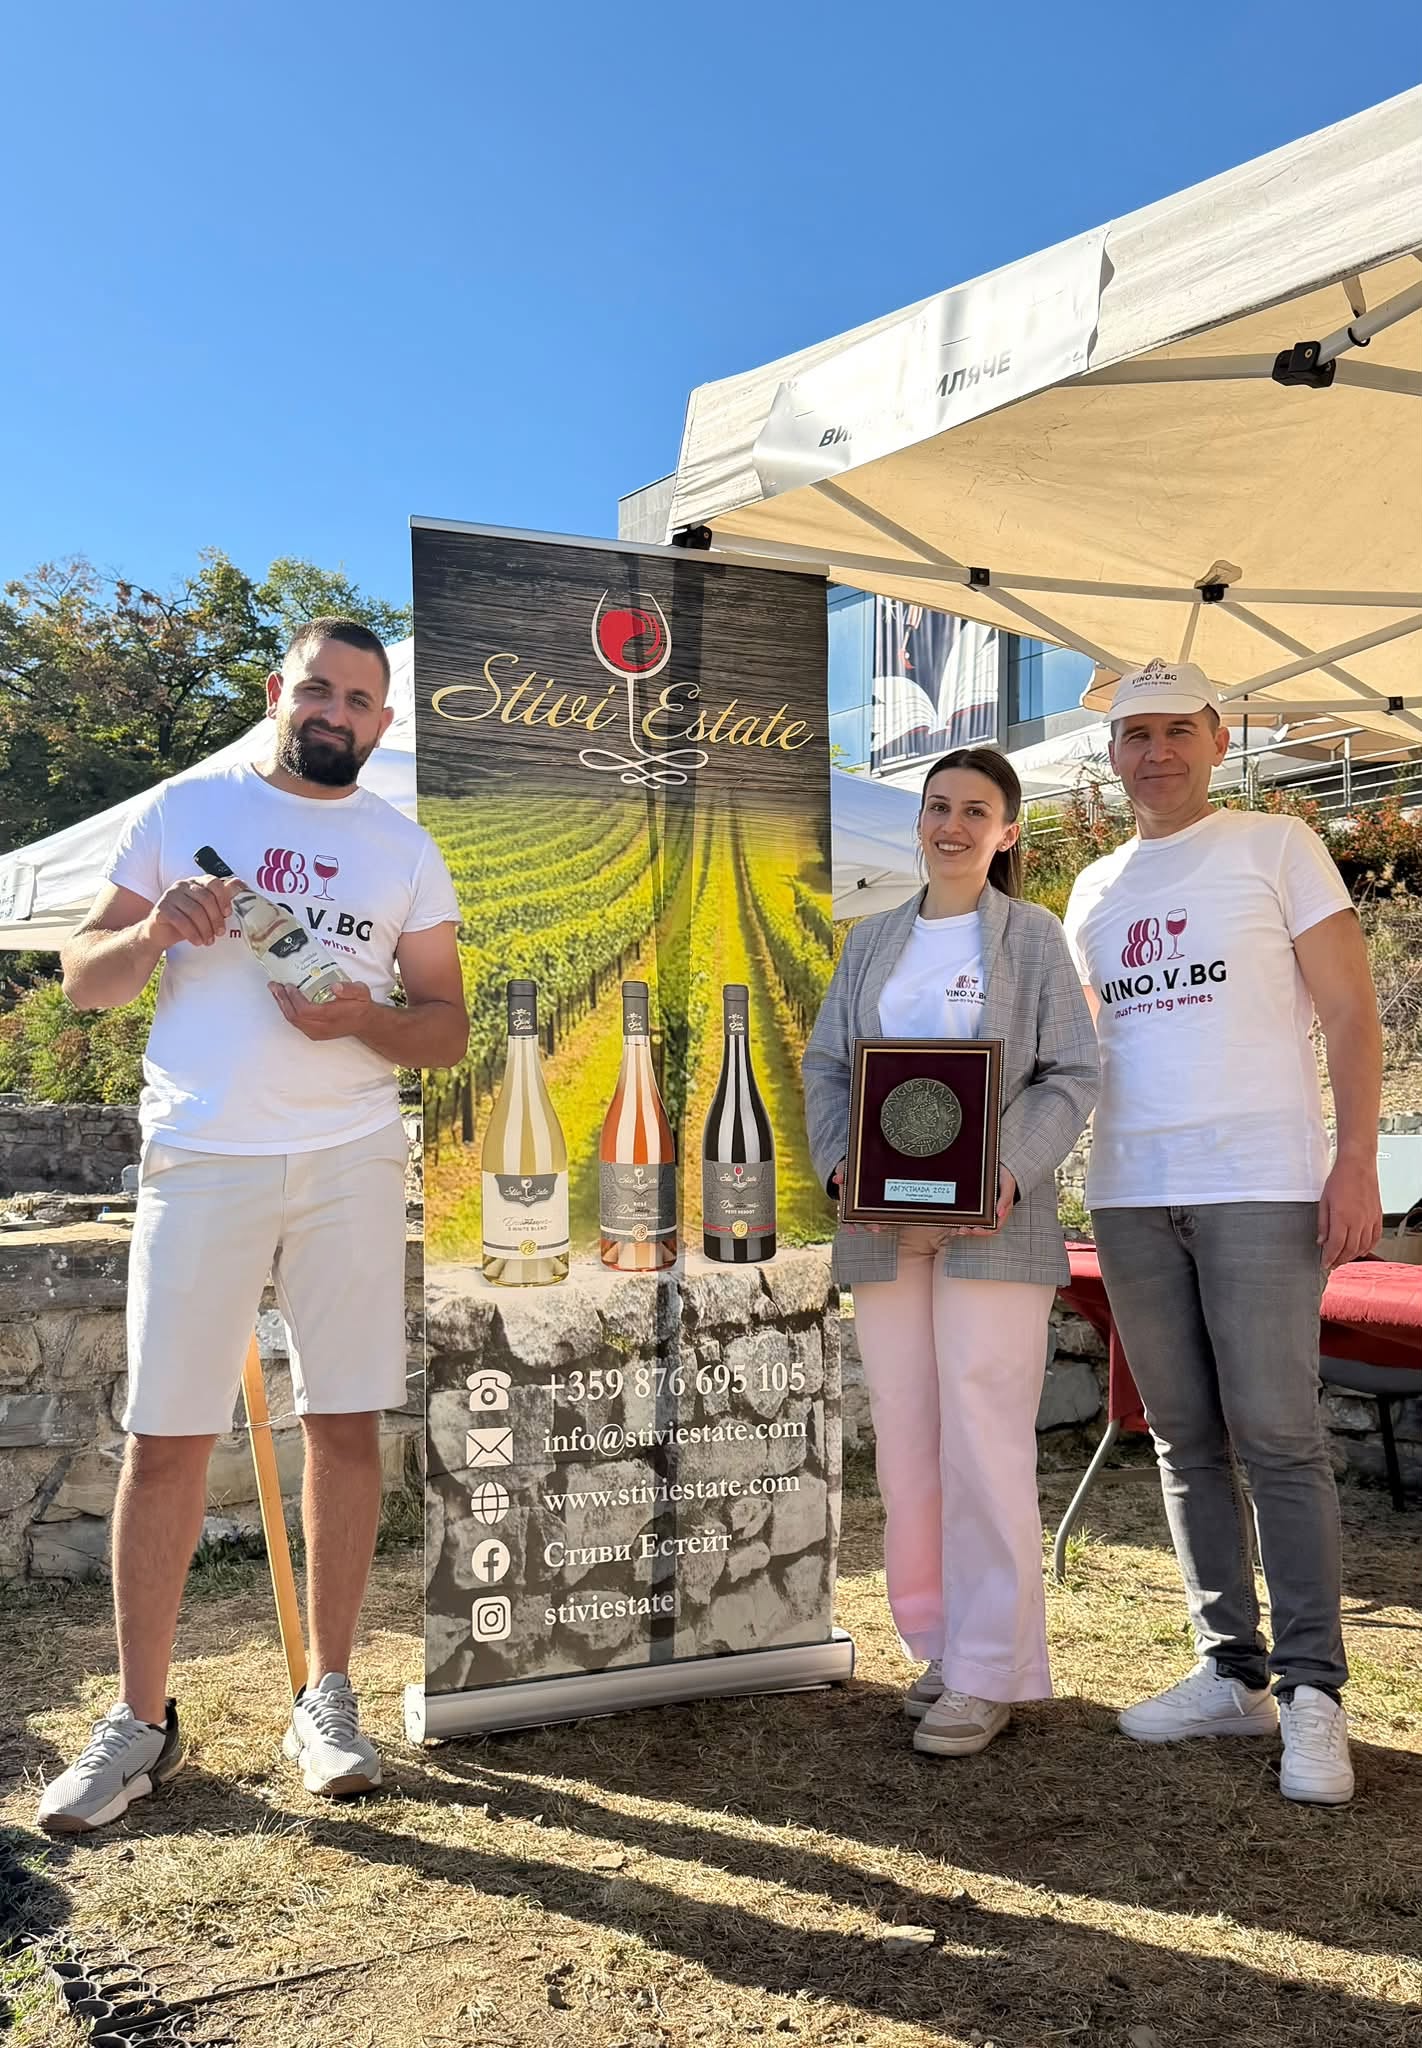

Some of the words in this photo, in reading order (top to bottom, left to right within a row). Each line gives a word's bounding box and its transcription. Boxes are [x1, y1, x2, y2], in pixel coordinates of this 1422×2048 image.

[431, 653, 618, 731] Stivi
[641, 682, 814, 750] Estate
[321, 938, 357, 955] wines
[1100, 960, 1227, 1005] VINO.V.BG
[1156, 999, 1174, 1012] bg
[1177, 993, 1213, 1006] wines
[542, 1368, 624, 1402] +359
[634, 1367, 686, 1398] 876
[695, 1364, 748, 1395] 695
[757, 1362, 806, 1393] 105
[543, 1421, 808, 1457] info@stiviestate.com
[543, 1475, 801, 1511] www.stiviestate.com
[543, 1541, 633, 1568] Стиви
[638, 1529, 733, 1559] Естейт
[544, 1592, 675, 1625] stiviestate
